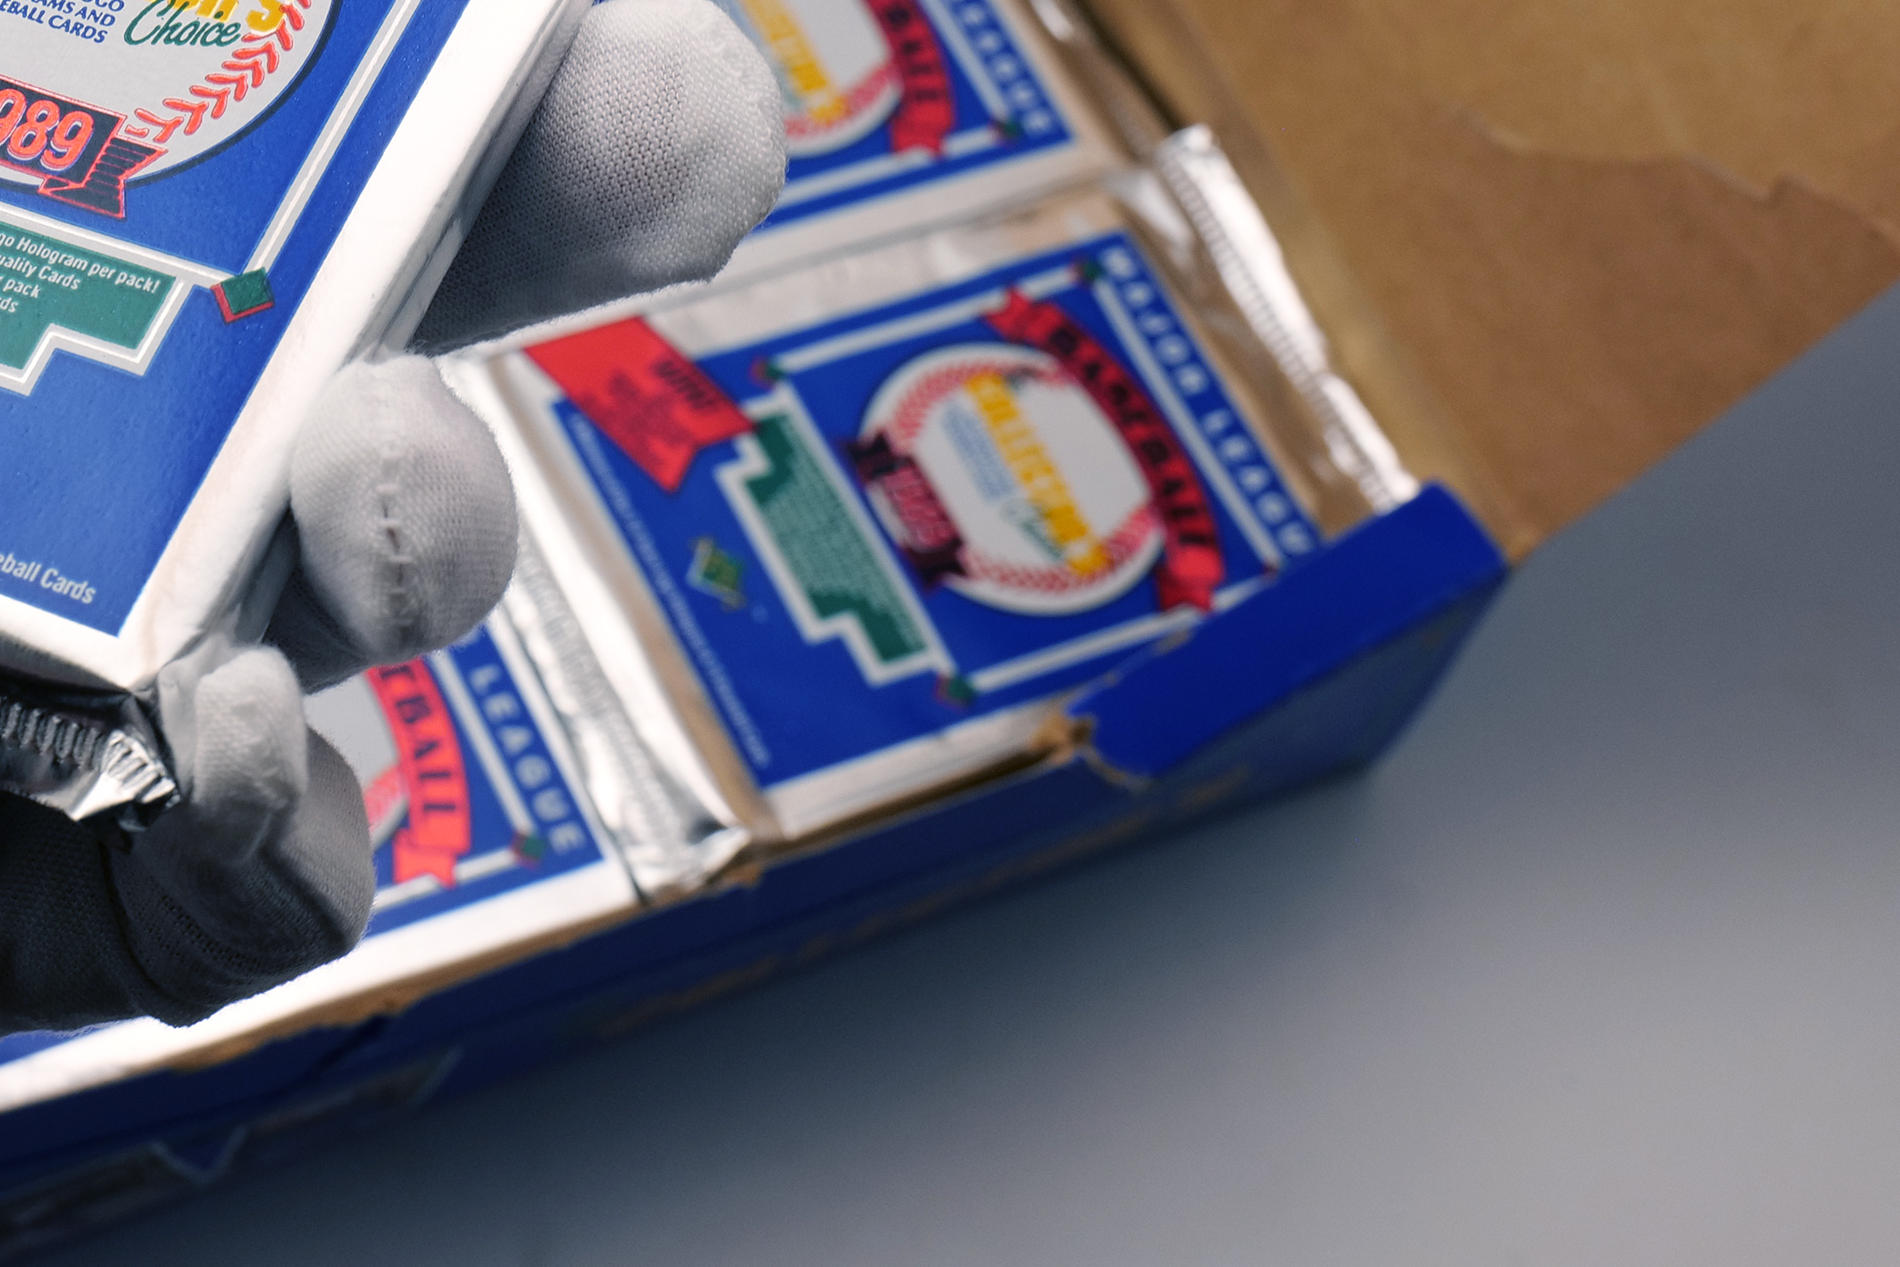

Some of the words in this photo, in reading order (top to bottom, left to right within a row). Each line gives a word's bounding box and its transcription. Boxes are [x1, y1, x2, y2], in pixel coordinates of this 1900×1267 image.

[48, 15, 108, 43] CARDS
[74, 6, 116, 27] AND
[16, 237, 88, 271] Hologram
[87, 263, 116, 279] per
[115, 271, 161, 294] pack!
[38, 266, 82, 290] Cards
[2, 278, 41, 299] pack
[1200, 406, 1317, 556] LEAGU
[40, 568, 97, 604] Cards
[468, 663, 588, 858] LEAGUE
